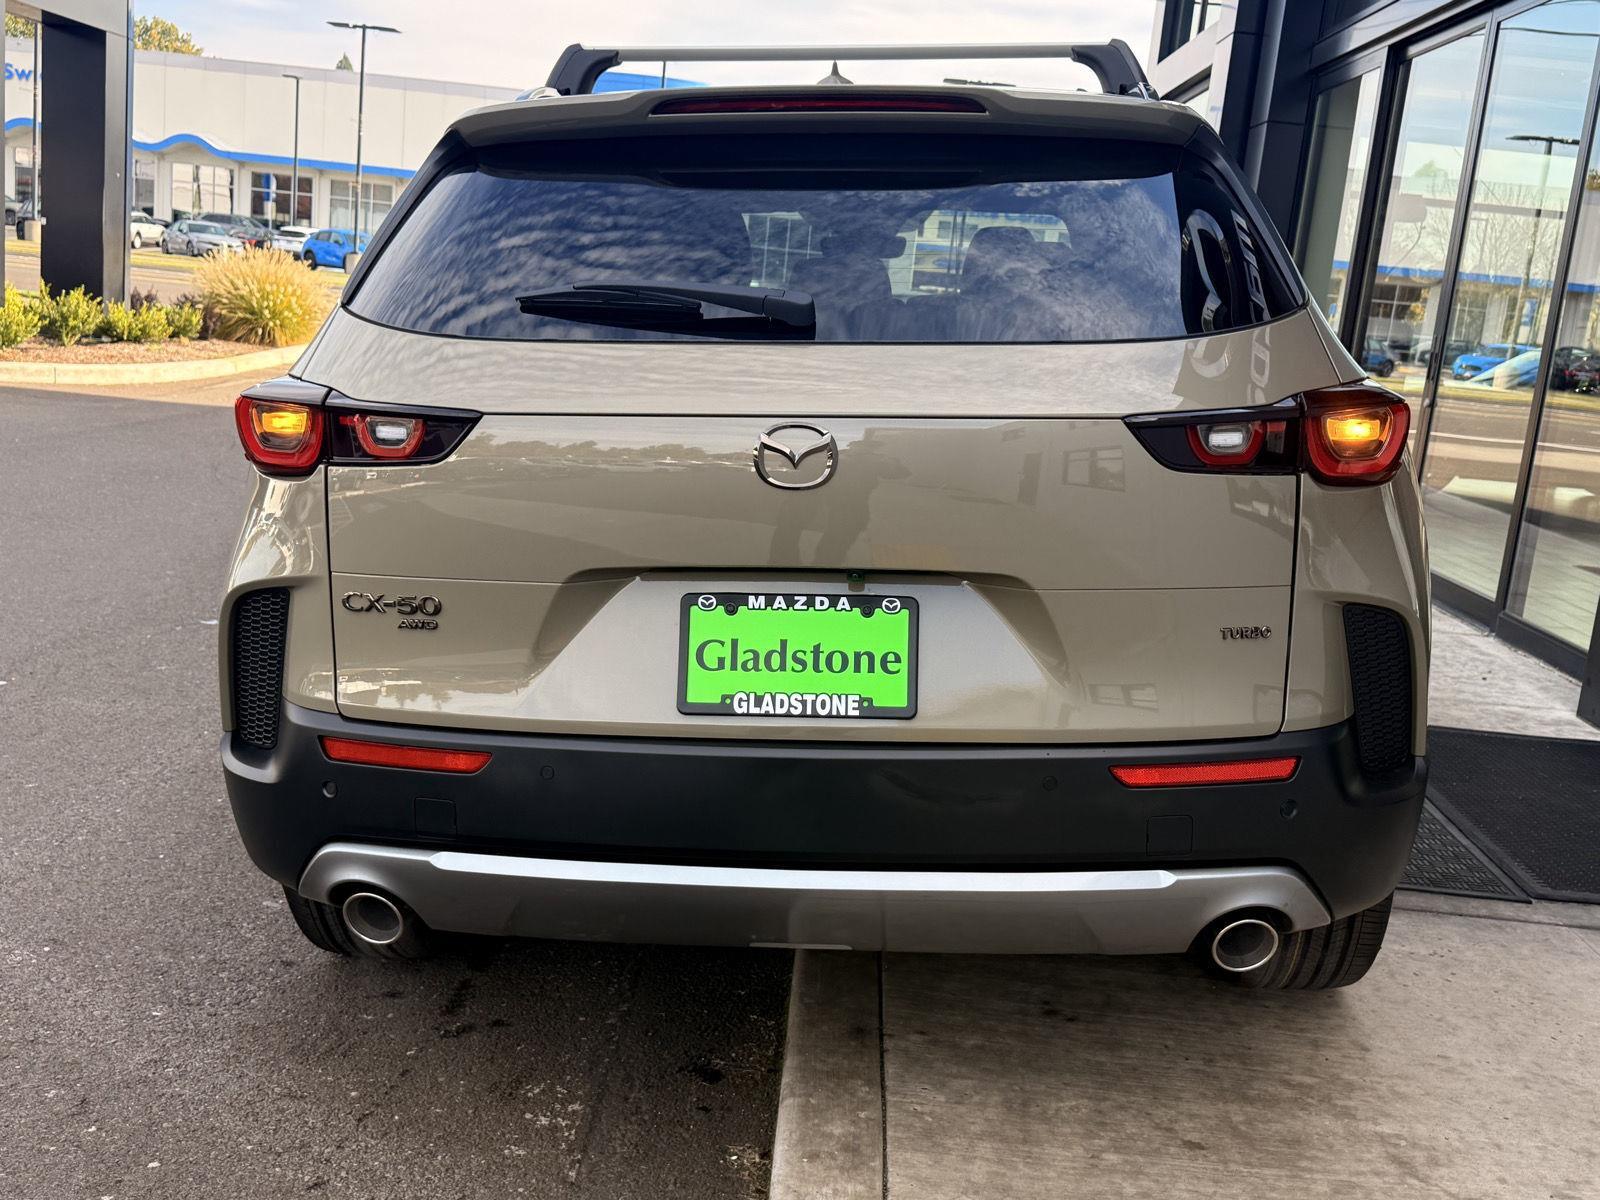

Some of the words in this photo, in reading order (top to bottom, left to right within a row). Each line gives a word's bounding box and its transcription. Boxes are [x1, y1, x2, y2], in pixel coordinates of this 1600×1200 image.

[341, 591, 443, 616] CX-50
[747, 595, 851, 611] MAZDA
[397, 618, 439, 631] AWD
[1219, 625, 1272, 641] TURBO
[695, 638, 903, 675] Gladstone
[732, 692, 861, 716] GLADSTONE
